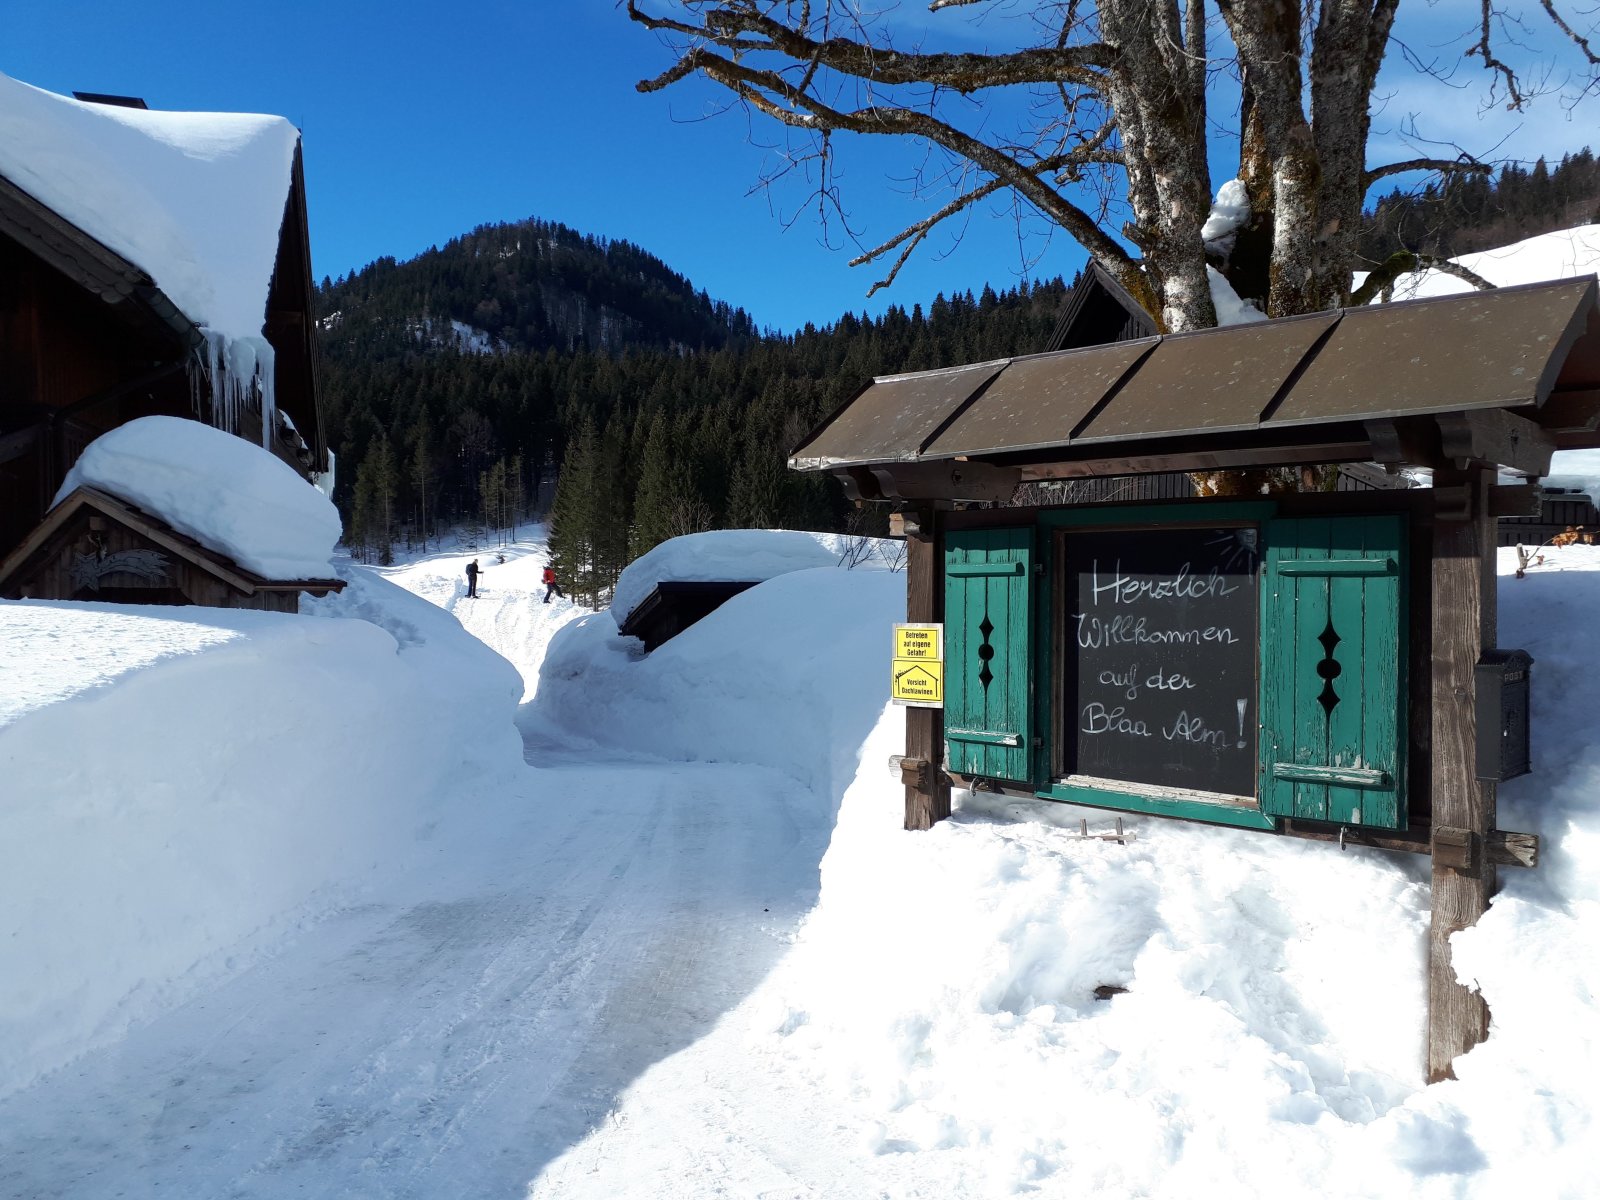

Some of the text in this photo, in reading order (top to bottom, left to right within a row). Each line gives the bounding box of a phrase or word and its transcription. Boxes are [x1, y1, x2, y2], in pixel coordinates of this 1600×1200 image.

[1091, 558, 1239, 606] Herzlich
[1071, 613, 1239, 648] Willkommen
[901, 687, 933, 695] Dachlawinen
[907, 678, 927, 686] Vorsicht
[1100, 663, 1196, 700] auf der
[1082, 702, 1152, 736] Blaa
